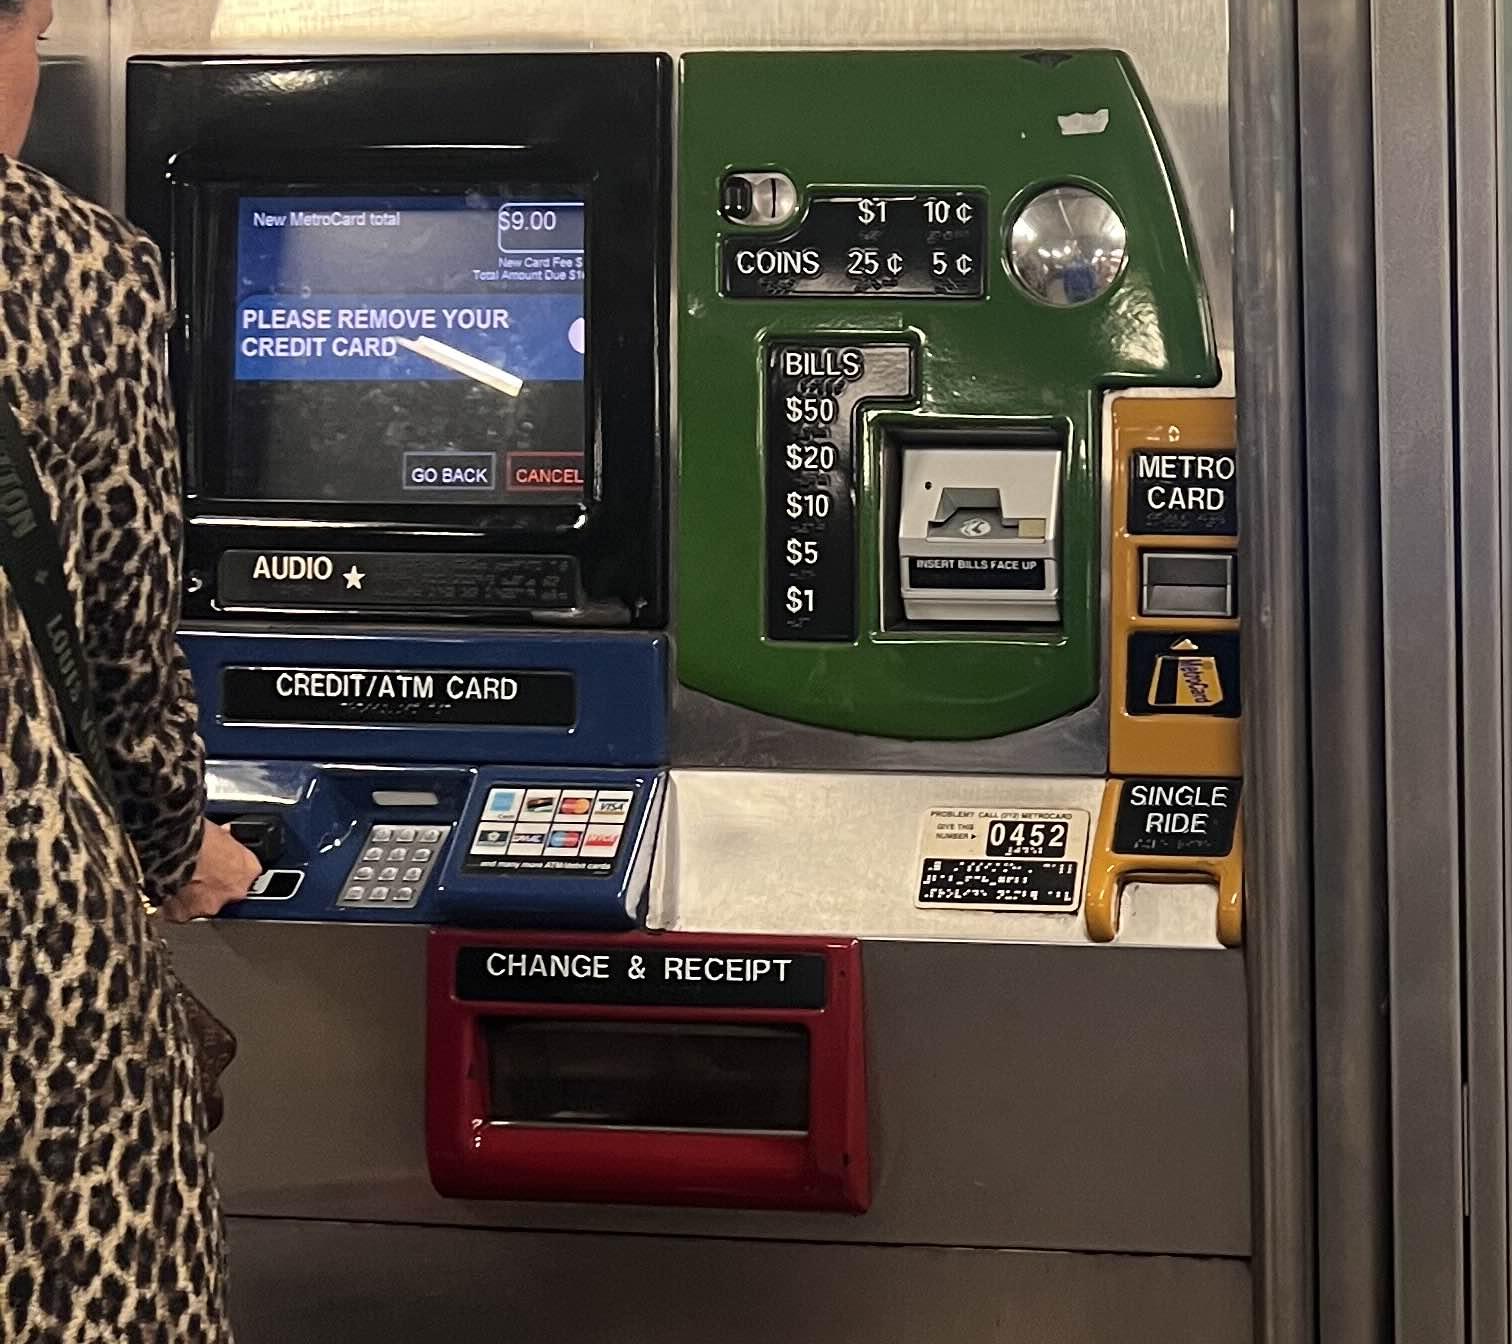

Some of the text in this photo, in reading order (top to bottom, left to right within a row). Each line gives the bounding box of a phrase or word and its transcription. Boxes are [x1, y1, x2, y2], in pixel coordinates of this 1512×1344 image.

[253, 211, 401, 227] New MetroCard total
[498, 210, 557, 231] $9.00
[858, 199, 888, 225] $1
[472, 269, 499, 281] Total
[501, 270, 543, 281] Amount
[544, 270, 567, 281] Due
[498, 258, 522, 268] New
[524, 257, 551, 268] Card
[552, 257, 574, 268] Fee
[736, 250, 821, 275] COINS
[242, 309, 510, 330] PLEASE REMOVE YOUR
[241, 337, 398, 357] CREDIT CARD
[785, 353, 862, 378] BILLS
[785, 396, 834, 424] $50
[785, 444, 835, 472] $20
[1138, 455, 1236, 481] METRO
[411, 467, 489, 484] GO BACK
[516, 467, 584, 484] CANCEL
[785, 492, 830, 520] $10
[1146, 486, 1226, 512] CARD
[785, 539, 819, 567] $5
[916, 559, 1038, 570] INSERT BILLS FACE UP
[252, 556, 333, 581] AUDIO
[785, 587, 815, 614] $1
[276, 672, 518, 701] CREDIT/ATM CARD
[1130, 785, 1231, 807] SINGLE
[989, 822, 1066, 848] 0452
[1145, 813, 1210, 835] RIDE
[485, 952, 793, 983] CHANGE & RECEIPT
